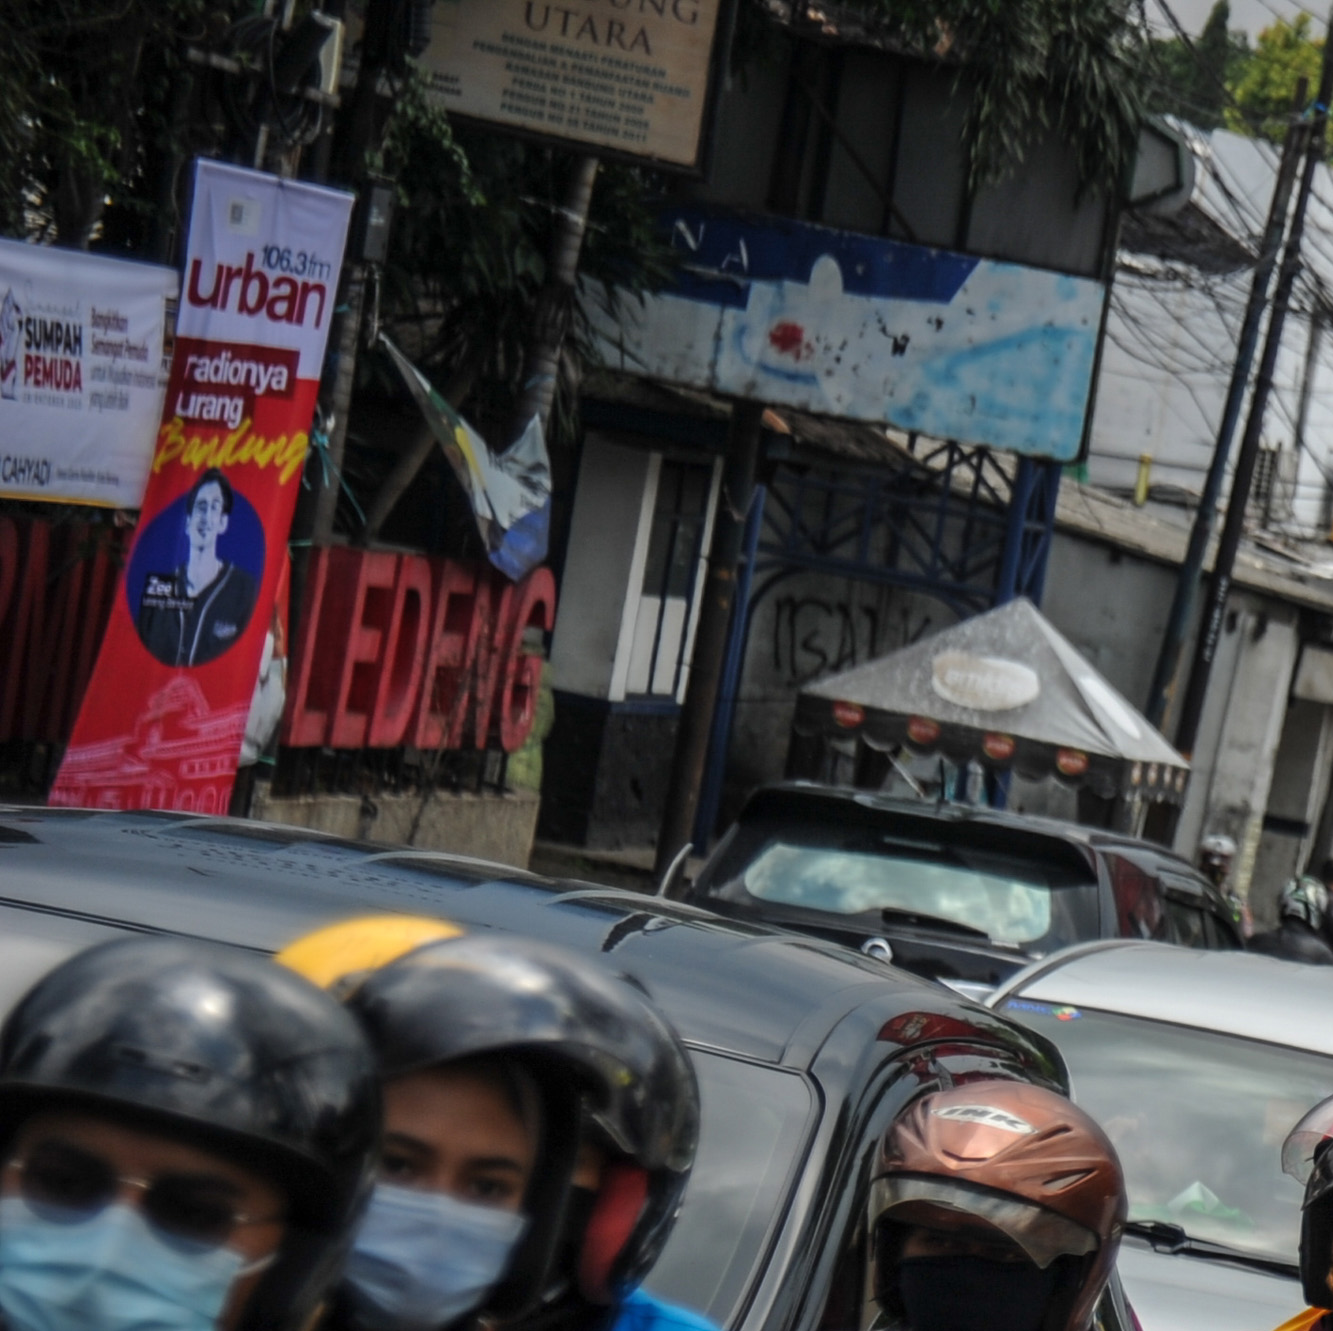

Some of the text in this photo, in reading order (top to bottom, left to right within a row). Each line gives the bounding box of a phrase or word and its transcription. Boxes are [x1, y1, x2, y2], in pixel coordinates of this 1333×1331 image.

[523, 2, 653, 56] UTARA
[187, 252, 327, 330] urban
[25, 316, 82, 358] SUMPAH
[24, 353, 82, 394] PEMUDA
[185, 351, 288, 396] radionya
[1, 455, 52, 487] CAHYADI
[152, 417, 309, 486] Bandung
[281, 546, 557, 753] LEDENG
[944, 1107, 1024, 1131] INK
